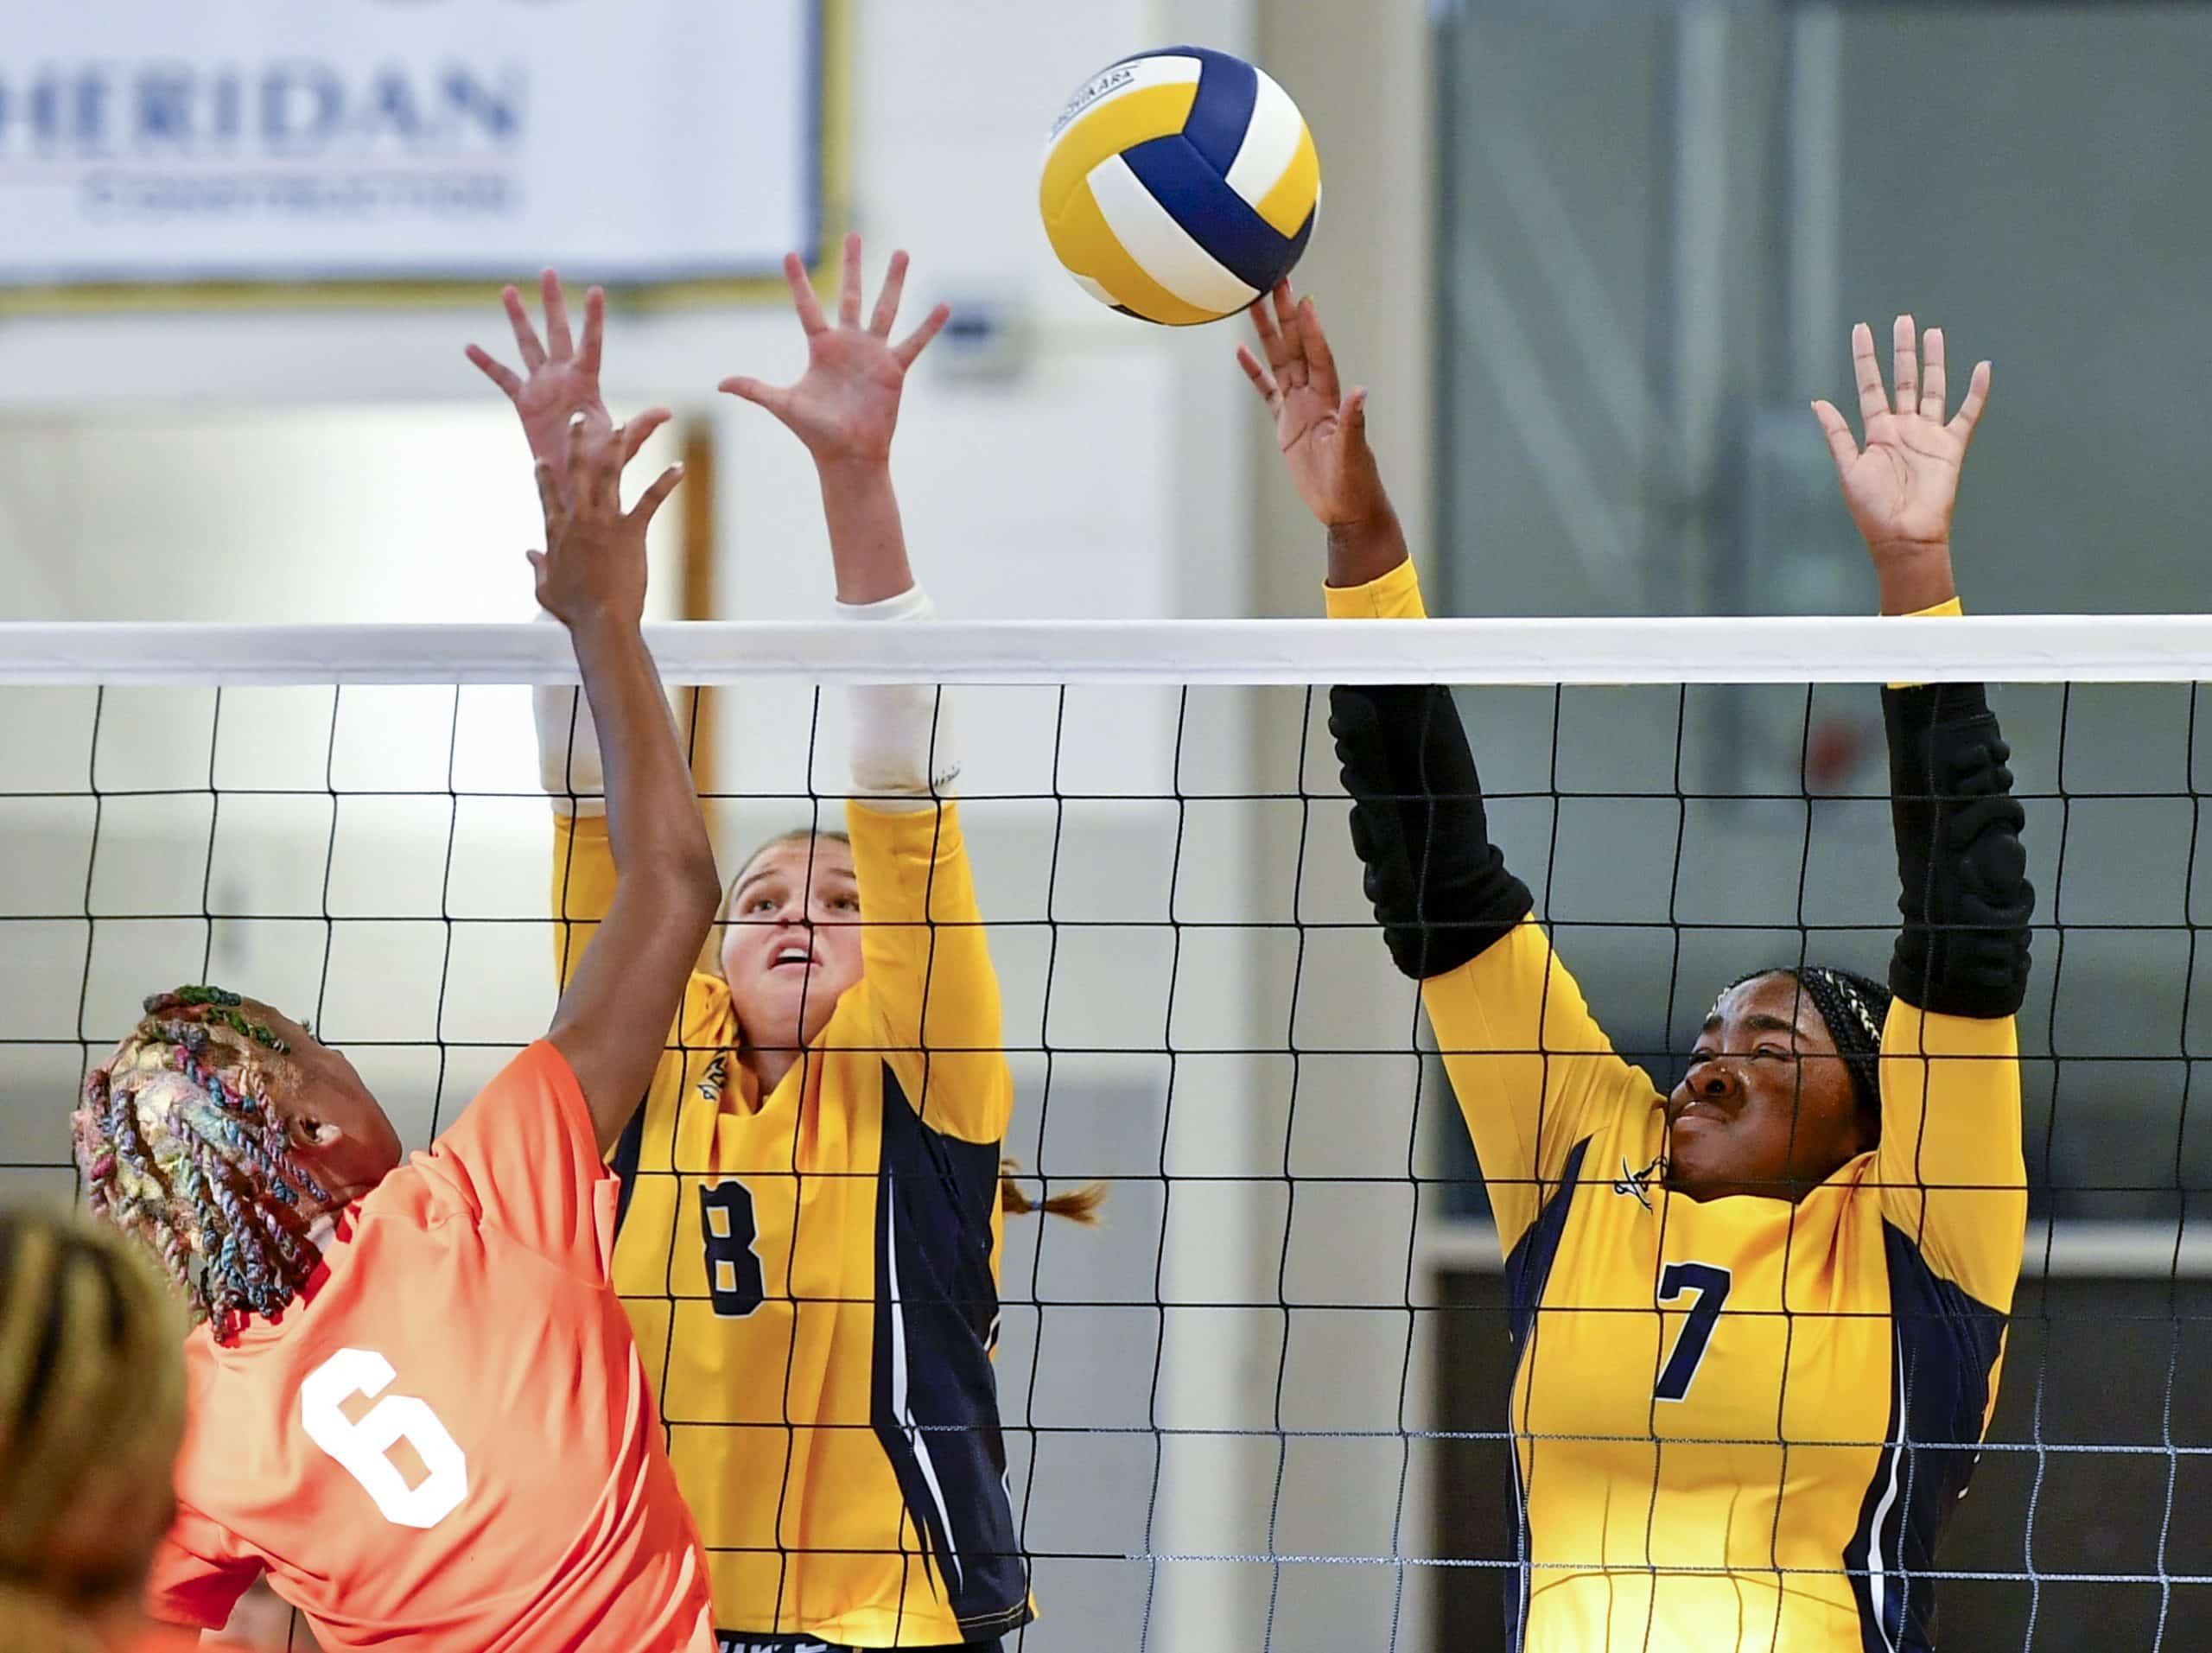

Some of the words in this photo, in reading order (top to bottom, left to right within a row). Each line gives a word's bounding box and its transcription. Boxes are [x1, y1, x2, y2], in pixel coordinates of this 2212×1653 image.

[698, 1179, 766, 1319] 8
[1651, 1262, 1732, 1403] 7
[301, 1346, 468, 1529] 6
